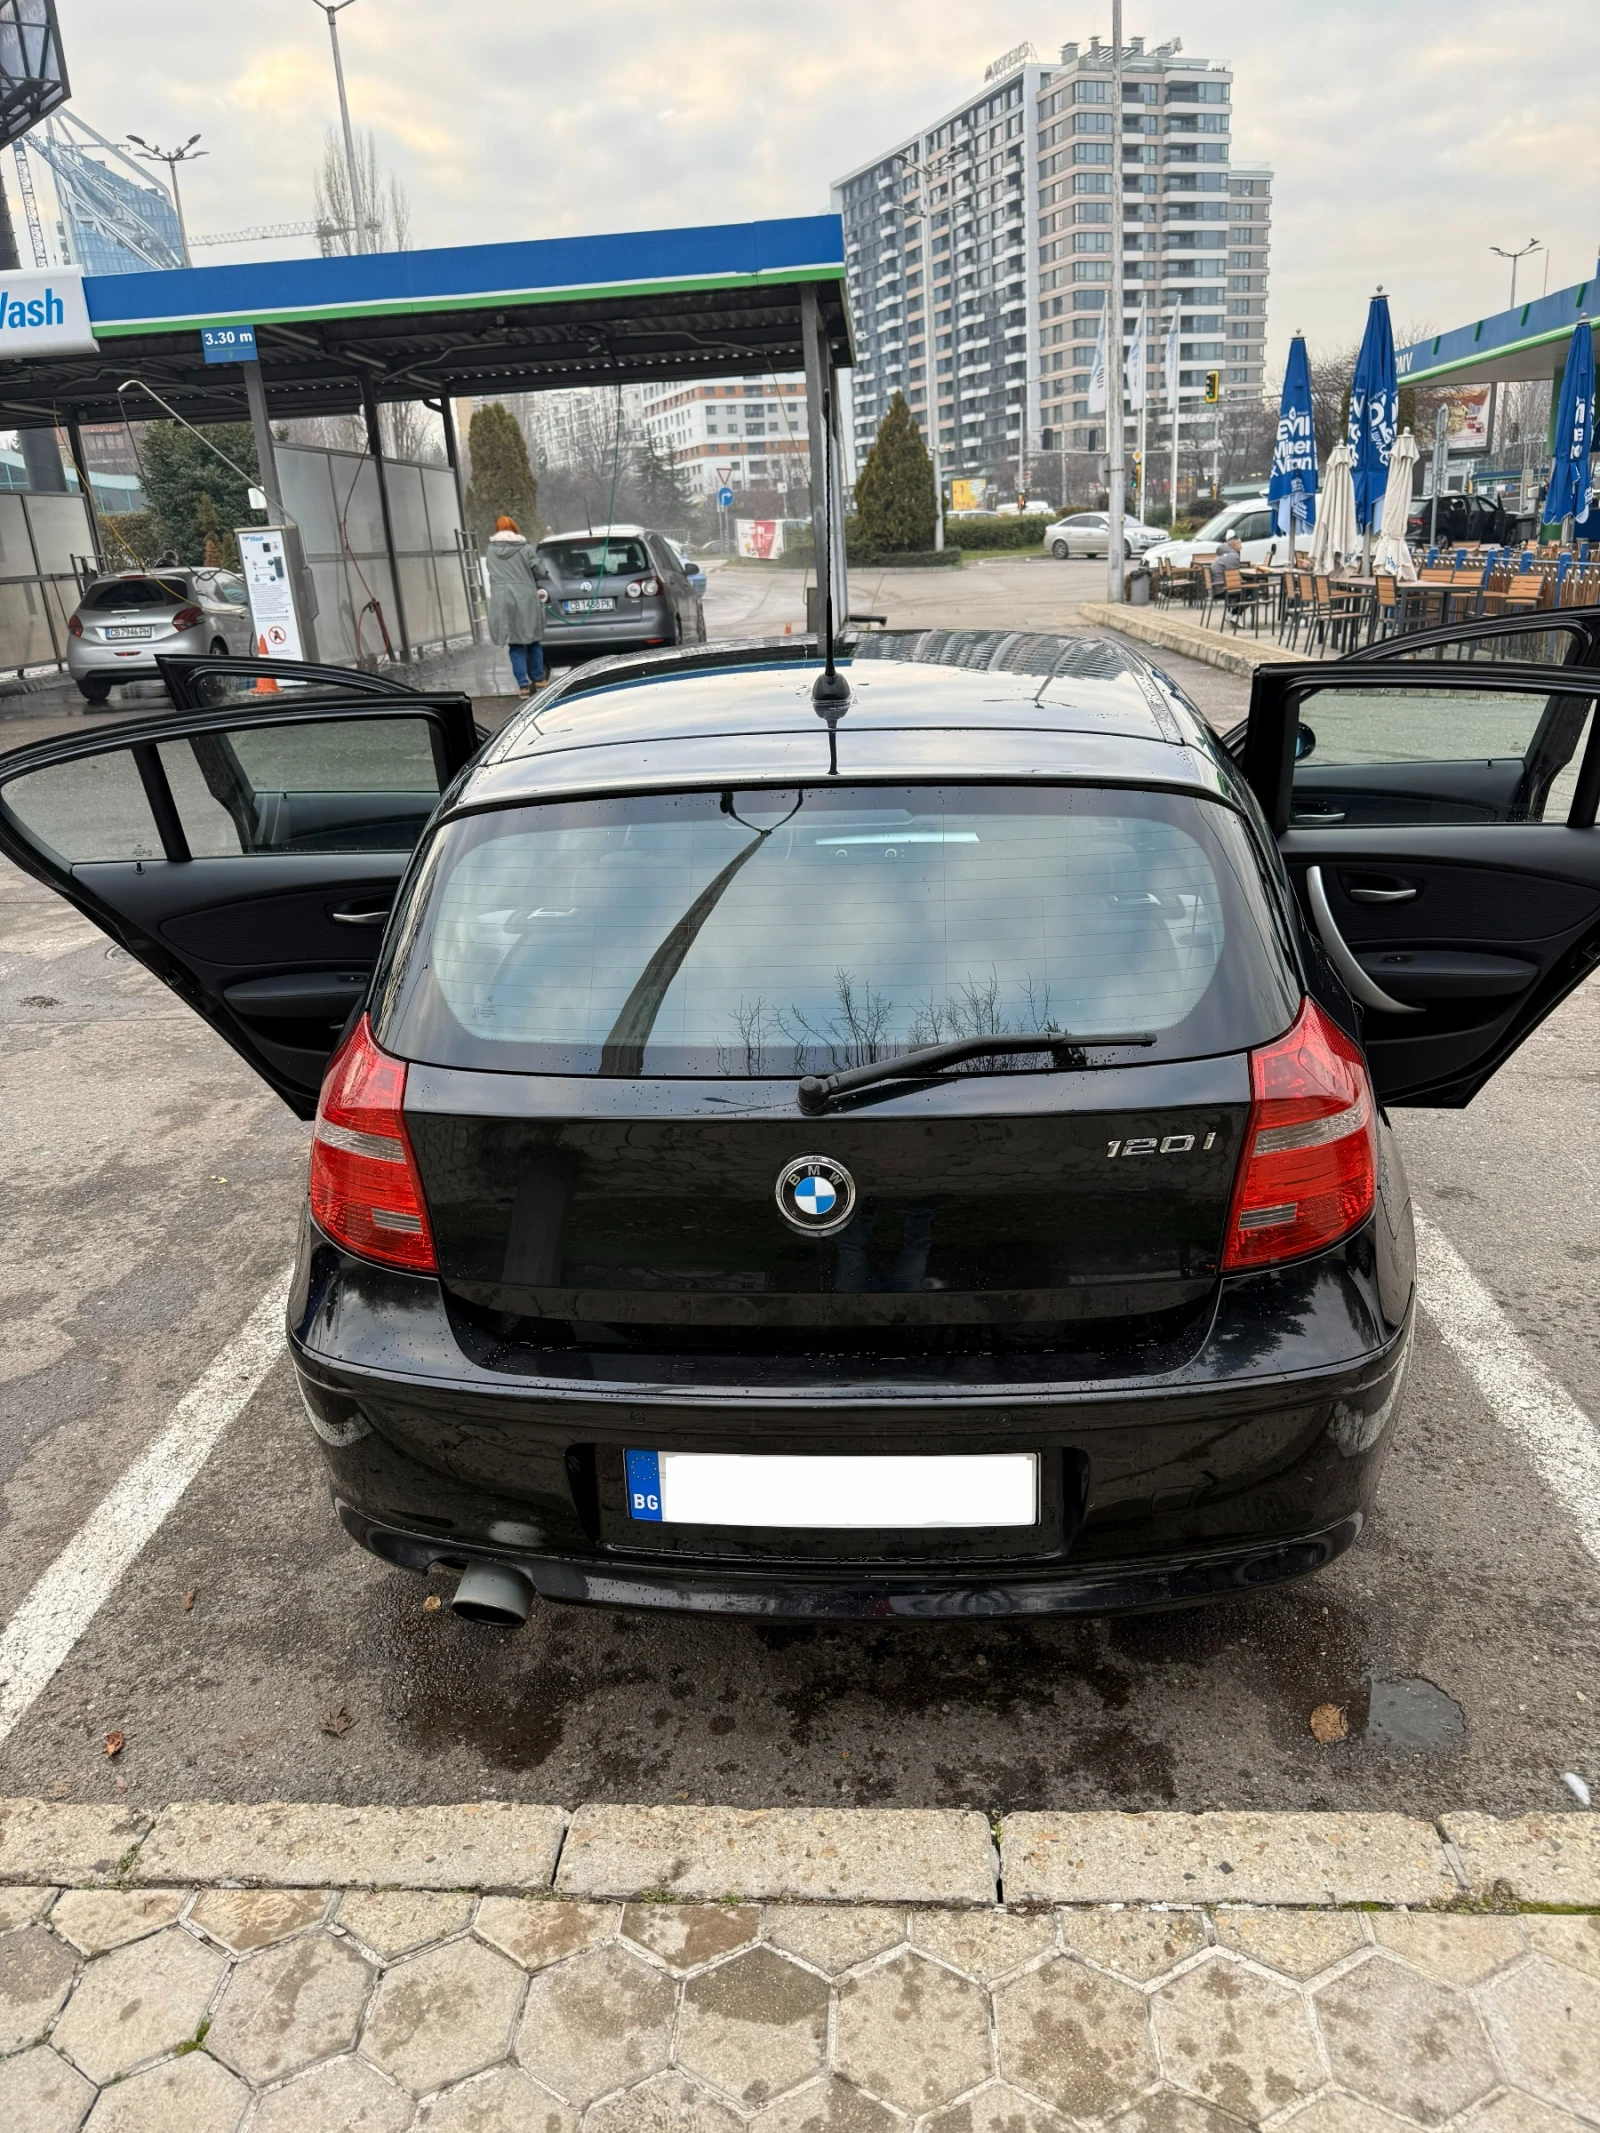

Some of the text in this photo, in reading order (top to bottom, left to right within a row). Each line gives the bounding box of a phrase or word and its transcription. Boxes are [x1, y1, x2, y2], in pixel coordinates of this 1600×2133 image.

[204, 330, 253, 346] 3.30 m
[788, 1165, 843, 1187] BMW
[633, 1493, 659, 1511] BG
